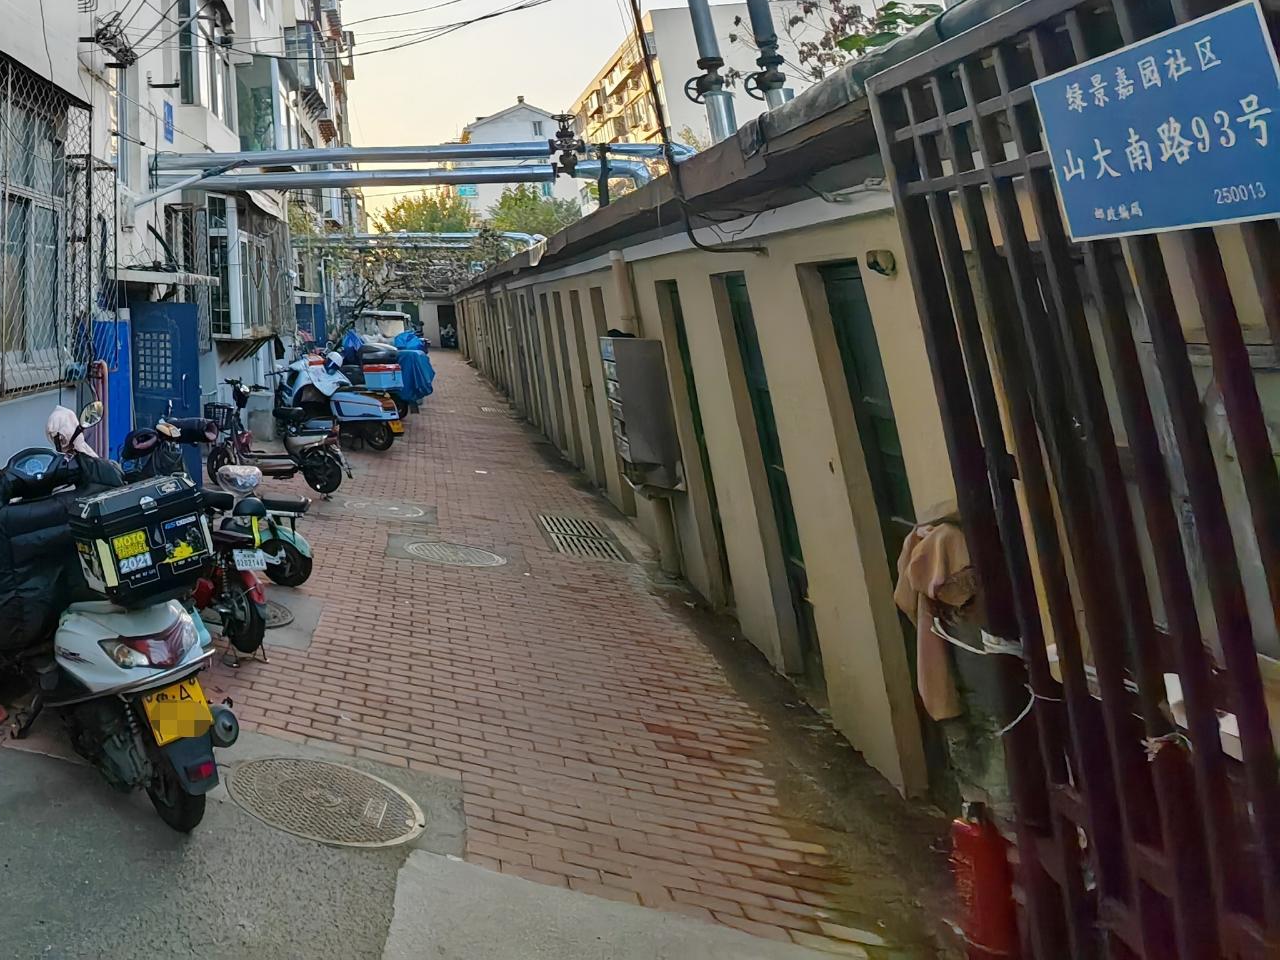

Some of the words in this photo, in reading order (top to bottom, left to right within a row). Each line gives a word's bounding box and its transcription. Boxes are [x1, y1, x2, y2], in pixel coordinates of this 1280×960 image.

[1065, 35, 1223, 113] 绿景嘉园社区
[1062, 93, 1272, 182] 山大南路93号
[1214, 181, 1267, 205] 250013
[1093, 201, 1143, 222] 邮政编码
[113, 530, 146, 548] MOTO
[119, 552, 153, 574] 2021
